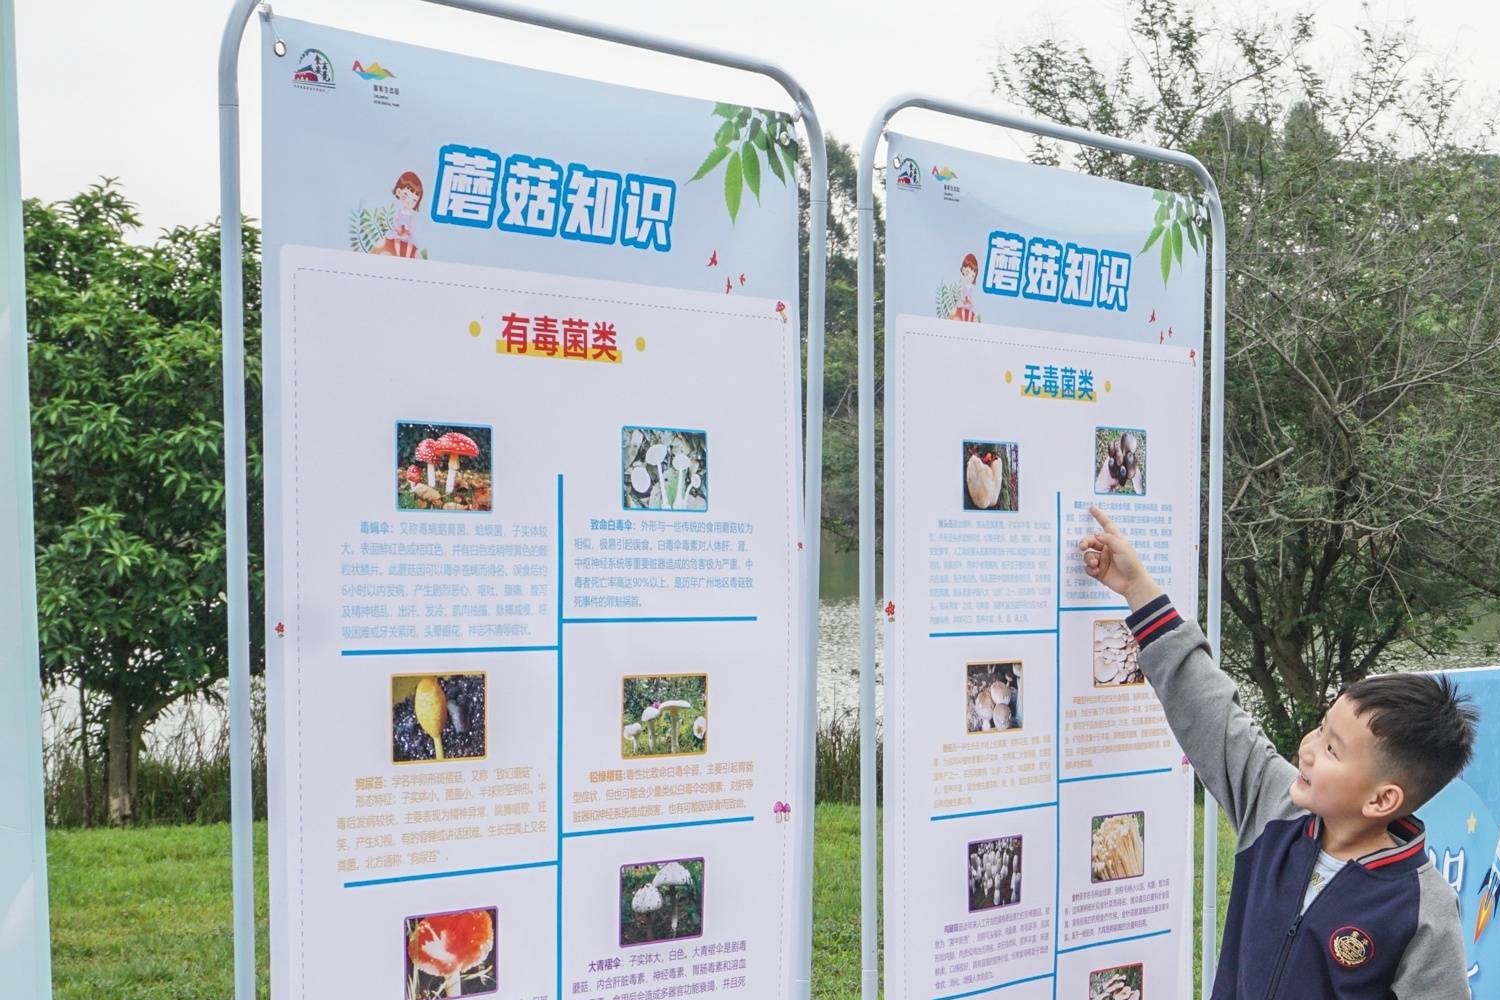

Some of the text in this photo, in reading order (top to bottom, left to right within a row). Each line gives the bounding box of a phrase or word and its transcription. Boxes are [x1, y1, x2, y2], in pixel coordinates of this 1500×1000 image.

[433, 144, 675, 252] 蘑菇知识
[984, 232, 1131, 312] 蘑菇知识
[502, 312, 618, 361] 有毒菌类
[1023, 364, 1094, 400] 无毒菌类
